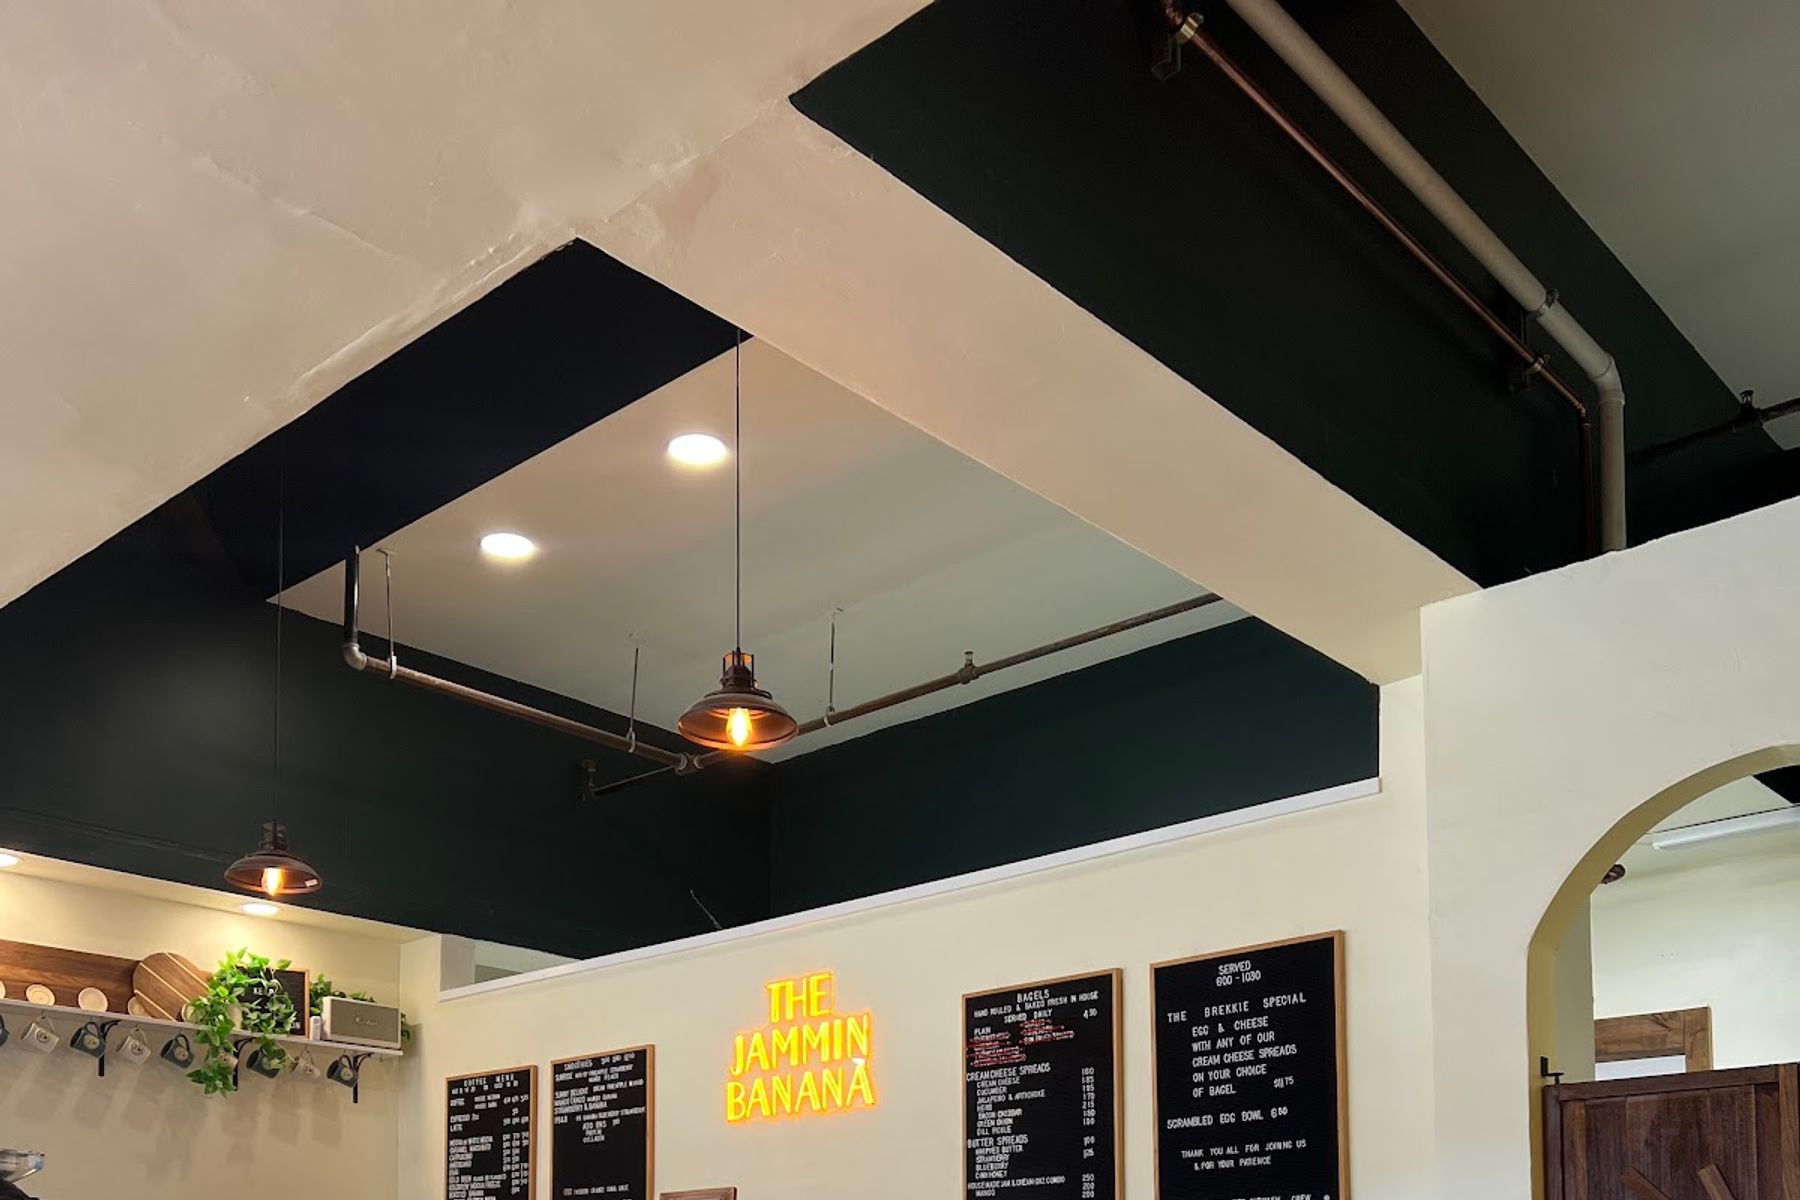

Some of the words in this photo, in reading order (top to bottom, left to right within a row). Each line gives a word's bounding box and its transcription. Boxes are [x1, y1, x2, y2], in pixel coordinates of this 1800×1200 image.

[1218, 960, 1252, 975] SERVED
[766, 972, 832, 1023] THE
[1017, 989, 1050, 1003] BAGELS
[1047, 995, 1068, 1006] FRESH
[1070, 994, 1077, 1003] IN
[1079, 990, 1100, 1001] HOUSE
[1004, 1012, 1027, 1024] SERVED
[1034, 1008, 1053, 1019] DAILY
[1167, 1011, 1187, 1023] THE
[1204, 1001, 1249, 1018] BREKKIE
[1263, 992, 1307, 1009] SPECIAL
[1191, 1025, 1209, 1037] EGG
[1218, 1023, 1225, 1033] &
[1234, 1016, 1268, 1031] CHEESE
[731, 1013, 869, 1076] JAMMIN
[1191, 1040, 1211, 1052] WITH
[1216, 1036, 1234, 1049] ANY
[1240, 1034, 1252, 1045] OF
[1257, 1031, 1275, 1043] OUR
[1192, 1054, 1220, 1068] CREAM
[1223, 1050, 1255, 1063] CHEESE
[1258, 1044, 1297, 1059] SPREADS
[967, 1070, 990, 1082] CREAM
[990, 1067, 1017, 1079] CHEESE
[1019, 1062, 1051, 1076] SPREADS
[1192, 1072, 1204, 1083] ON
[1208, 1068, 1231, 1081] YOUR
[1236, 1064, 1267, 1077] CHOICE
[726, 1064, 875, 1122] BANANA
[1192, 1087, 1204, 1098] OF
[1208, 1083, 1237, 1096] BAGEL
[1167, 1115, 1213, 1129] SCRAMBLED
[1220, 1112, 1236, 1124] EGG
[1241, 1110, 1264, 1121] BOWL
[967, 1137, 994, 1148] BUTTER
[997, 1134, 1029, 1146] SPREADS
[1181, 1148, 1204, 1159] THANK
[1209, 1147, 1223, 1156] YOU
[1226, 1145, 1239, 1155] ALL
[1245, 1143, 1260, 1153] FOR
[1296, 1139, 1307, 1148] US
[1194, 1162, 1199, 1171] &
[1201, 1161, 1214, 1170] FOR
[1218, 1159, 1235, 1169] YOUR
